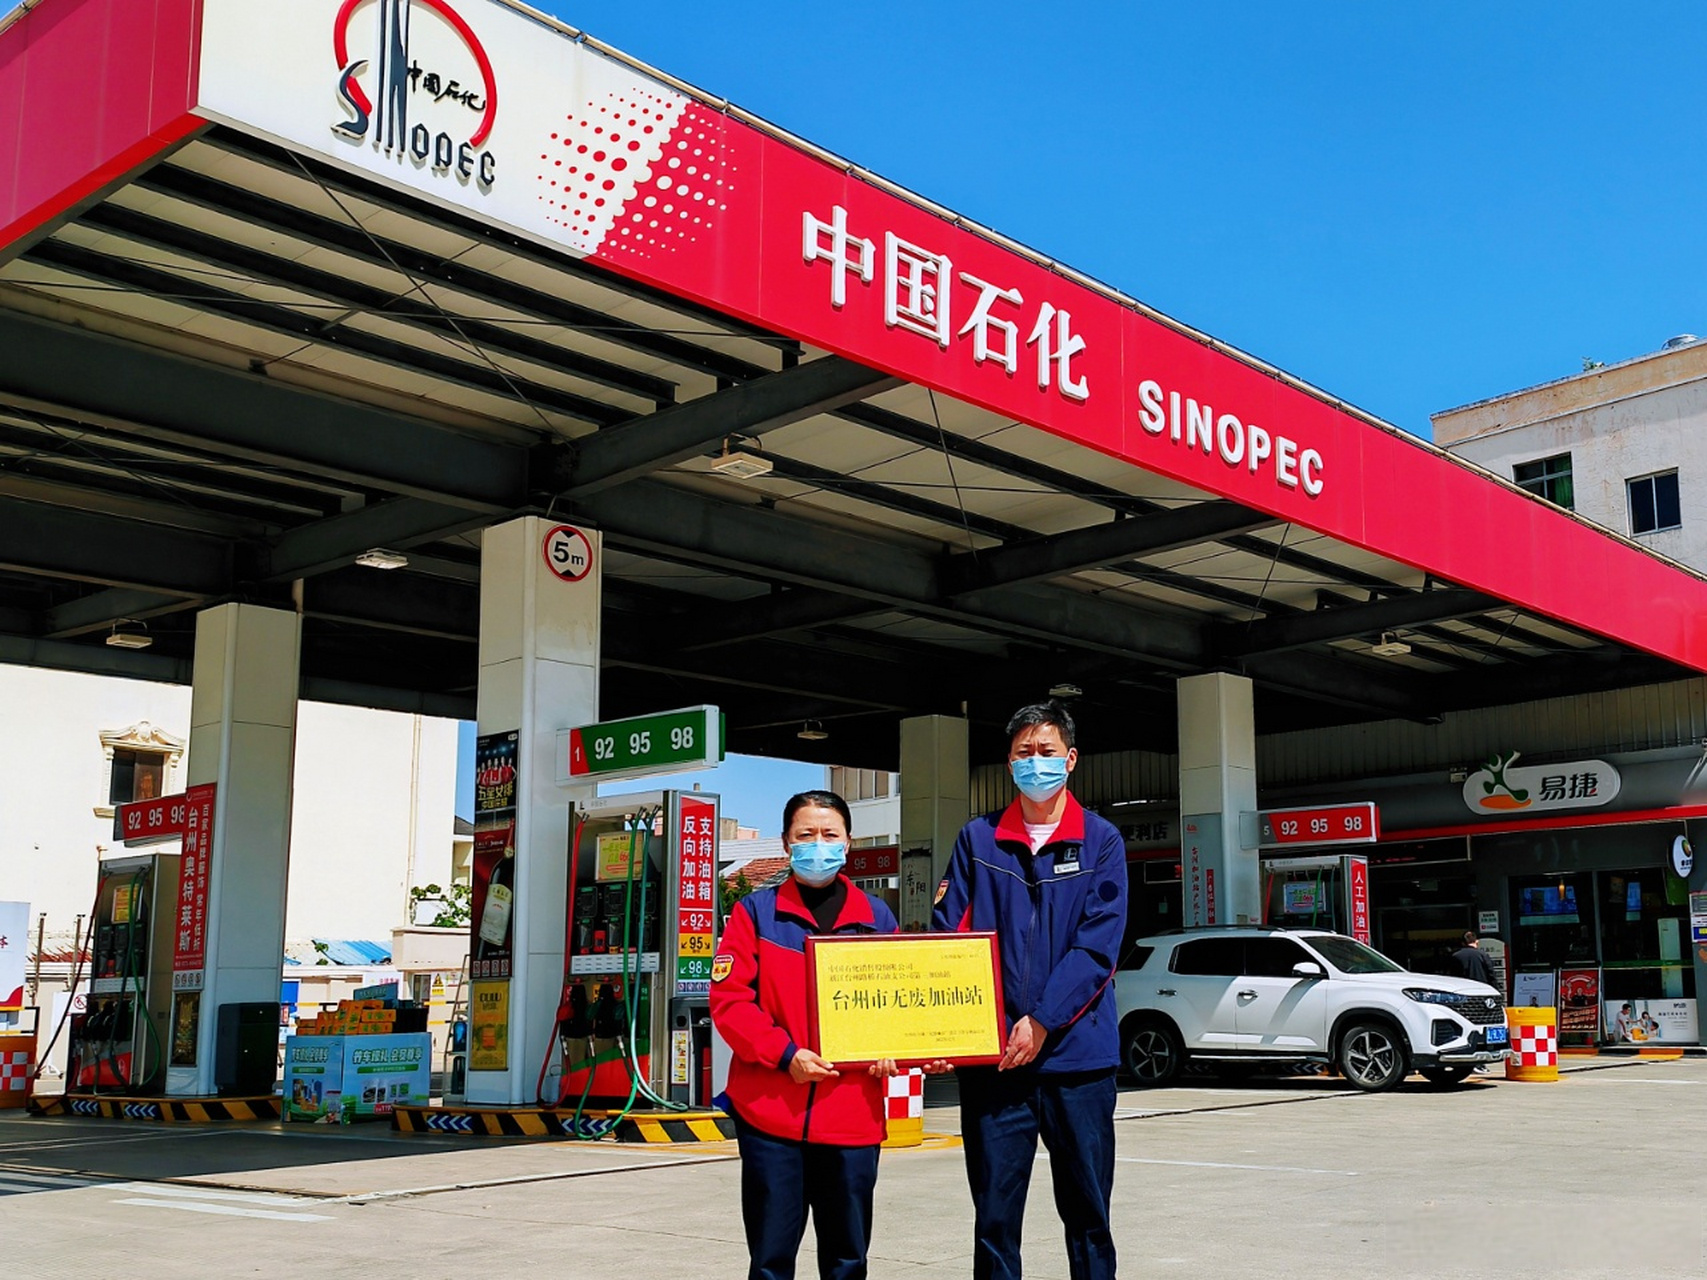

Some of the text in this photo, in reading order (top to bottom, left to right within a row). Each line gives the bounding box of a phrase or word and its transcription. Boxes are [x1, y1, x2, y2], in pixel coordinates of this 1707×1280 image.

[406, 60, 486, 112] 中国石化
[803, 205, 1089, 400] 中国石化
[1138, 380, 1324, 496] SINOPEC
[553, 541, 584, 566] 5m
[574, 726, 694, 762] 1 92 95 98
[1539, 772, 1599, 801] 易捷
[128, 804, 185, 830] 92 95 98
[1263, 815, 1362, 836] 5 92 95 98
[682, 815, 697, 900] 反向加油
[699, 816, 713, 901] 支持油箱
[854, 856, 891, 870] 95 98
[179, 807, 198, 952] 台州奥特莱斯
[1354, 870, 1366, 929] 人工加油
[690, 913, 704, 927] 92
[689, 936, 704, 950] 95
[688, 960, 703, 974] 98
[832, 985, 983, 1011] 台州市无废加油站
